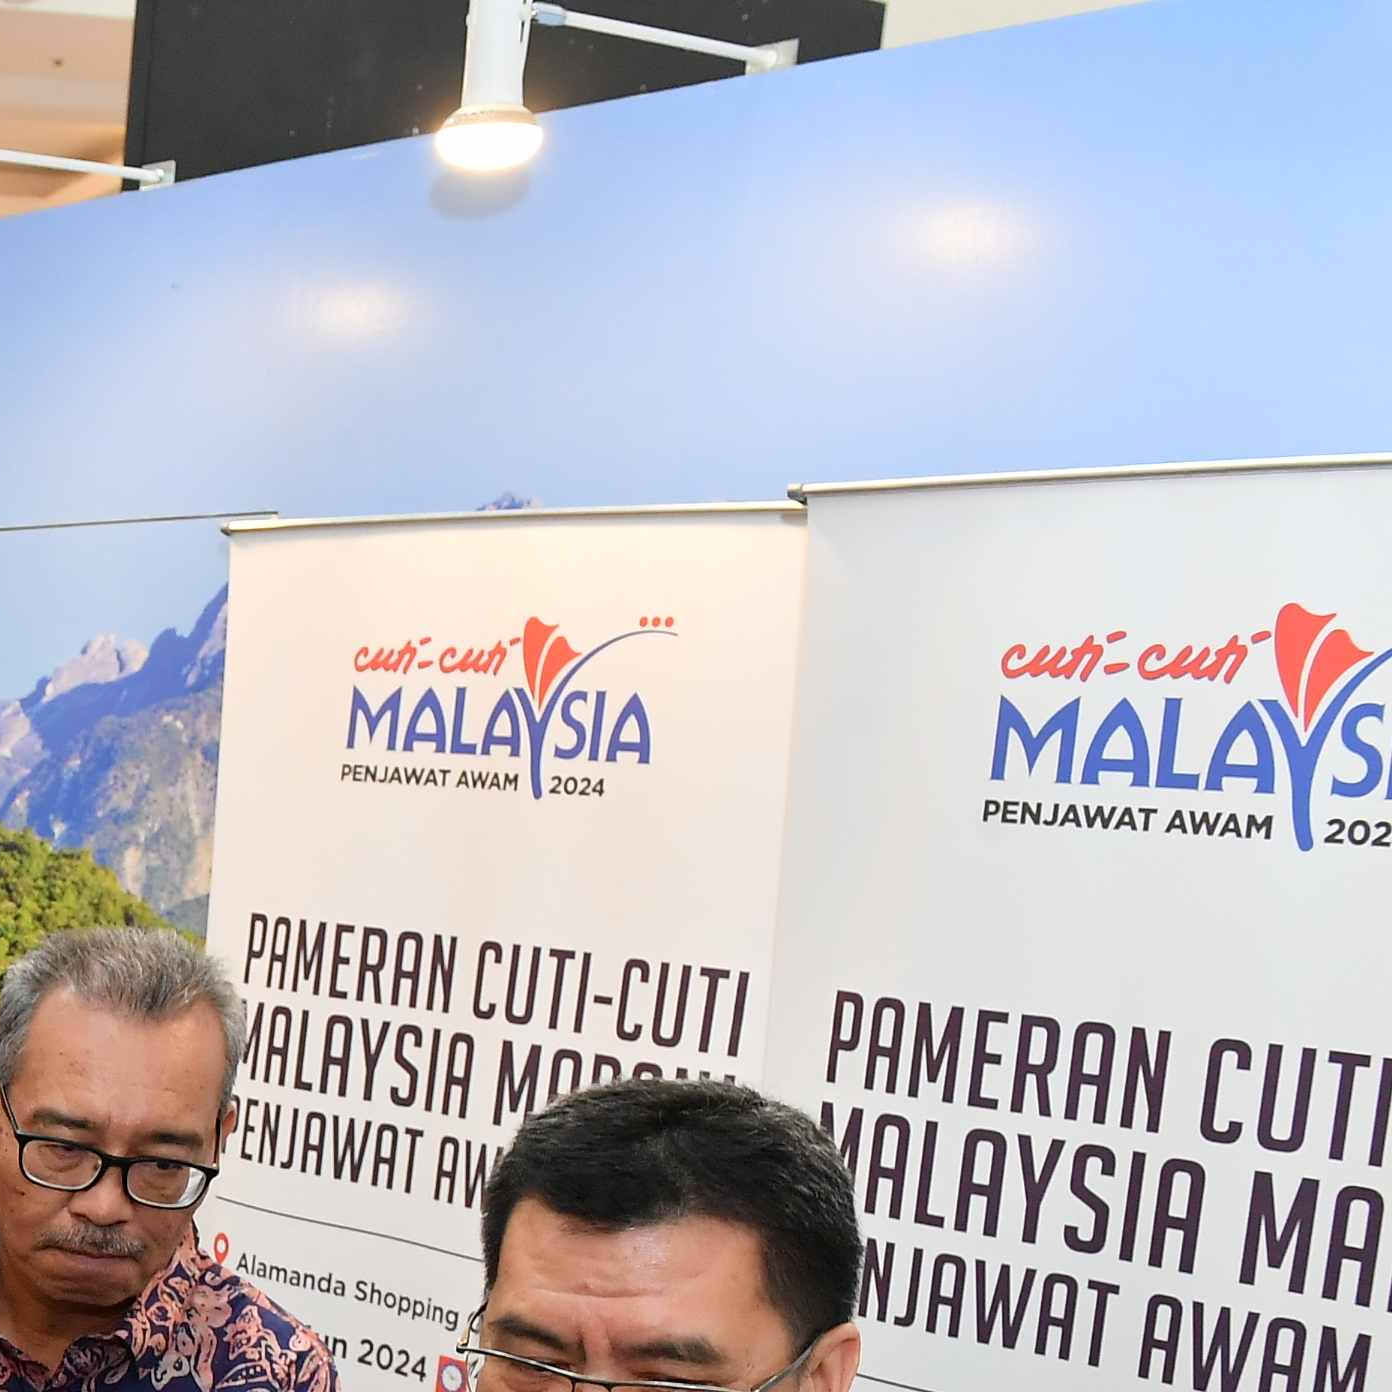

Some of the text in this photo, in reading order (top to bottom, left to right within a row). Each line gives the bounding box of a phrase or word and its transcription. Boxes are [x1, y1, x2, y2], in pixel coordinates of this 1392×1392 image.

[341, 763, 605, 798] PENJAWAT AWAM 2024
[345, 685, 651, 799] MALAYSIA
[989, 694, 1392, 851] MALAYS
[982, 799, 1158, 833] PENJAWAT
[1165, 808, 1274, 841] AWAM
[243, 913, 750, 1057] PAMERAN CUTI-CUTI
[826, 990, 1172, 1134] PAMERAN
[236, 1253, 346, 1297] Alamanda
[354, 1280, 460, 1331] Shopping
[857, 1237, 1121, 1368] NJAWAT
[1239, 1170, 1392, 1313] MA
[357, 1339, 427, 1382] 2024
